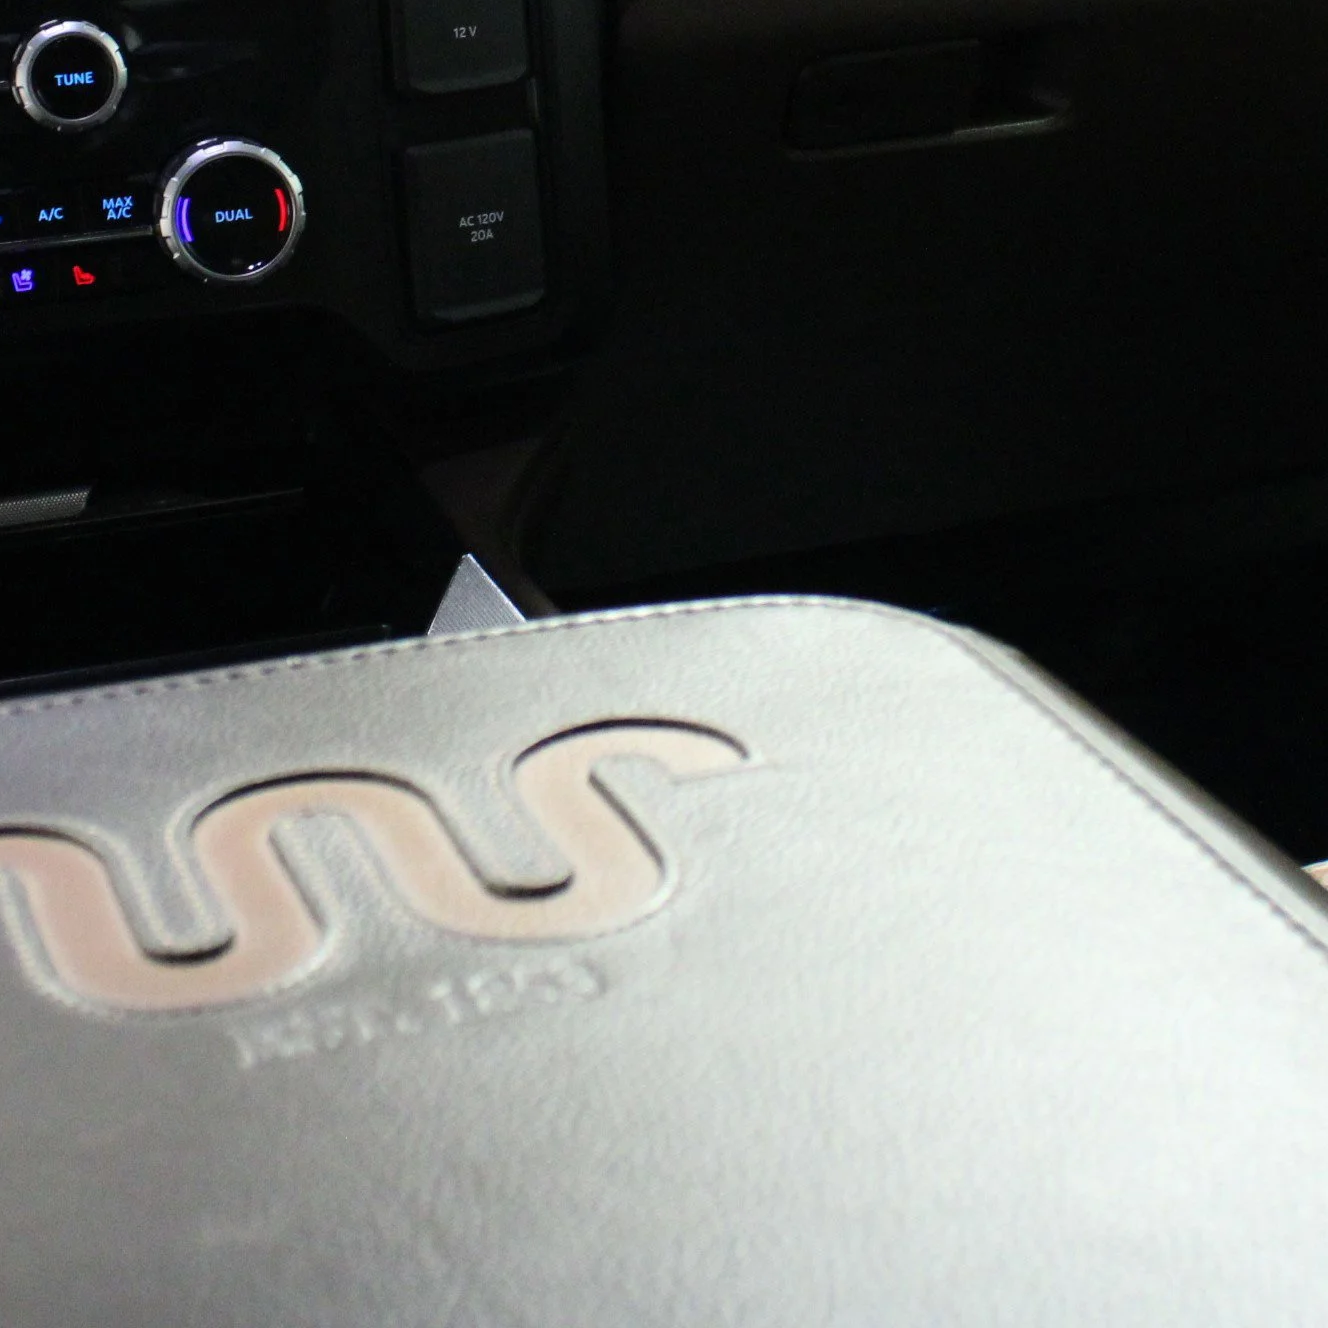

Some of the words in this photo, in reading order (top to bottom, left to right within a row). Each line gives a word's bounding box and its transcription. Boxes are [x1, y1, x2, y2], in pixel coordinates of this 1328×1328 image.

[54, 71, 95, 87] TUNE
[102, 195, 133, 210] MAX
[38, 207, 64, 222] A/C
[106, 206, 133, 221] A/C
[214, 208, 253, 223] DUAL
[459, 215, 475, 228] AC
[477, 211, 504, 226] 120V
[470, 228, 494, 242] 20A
